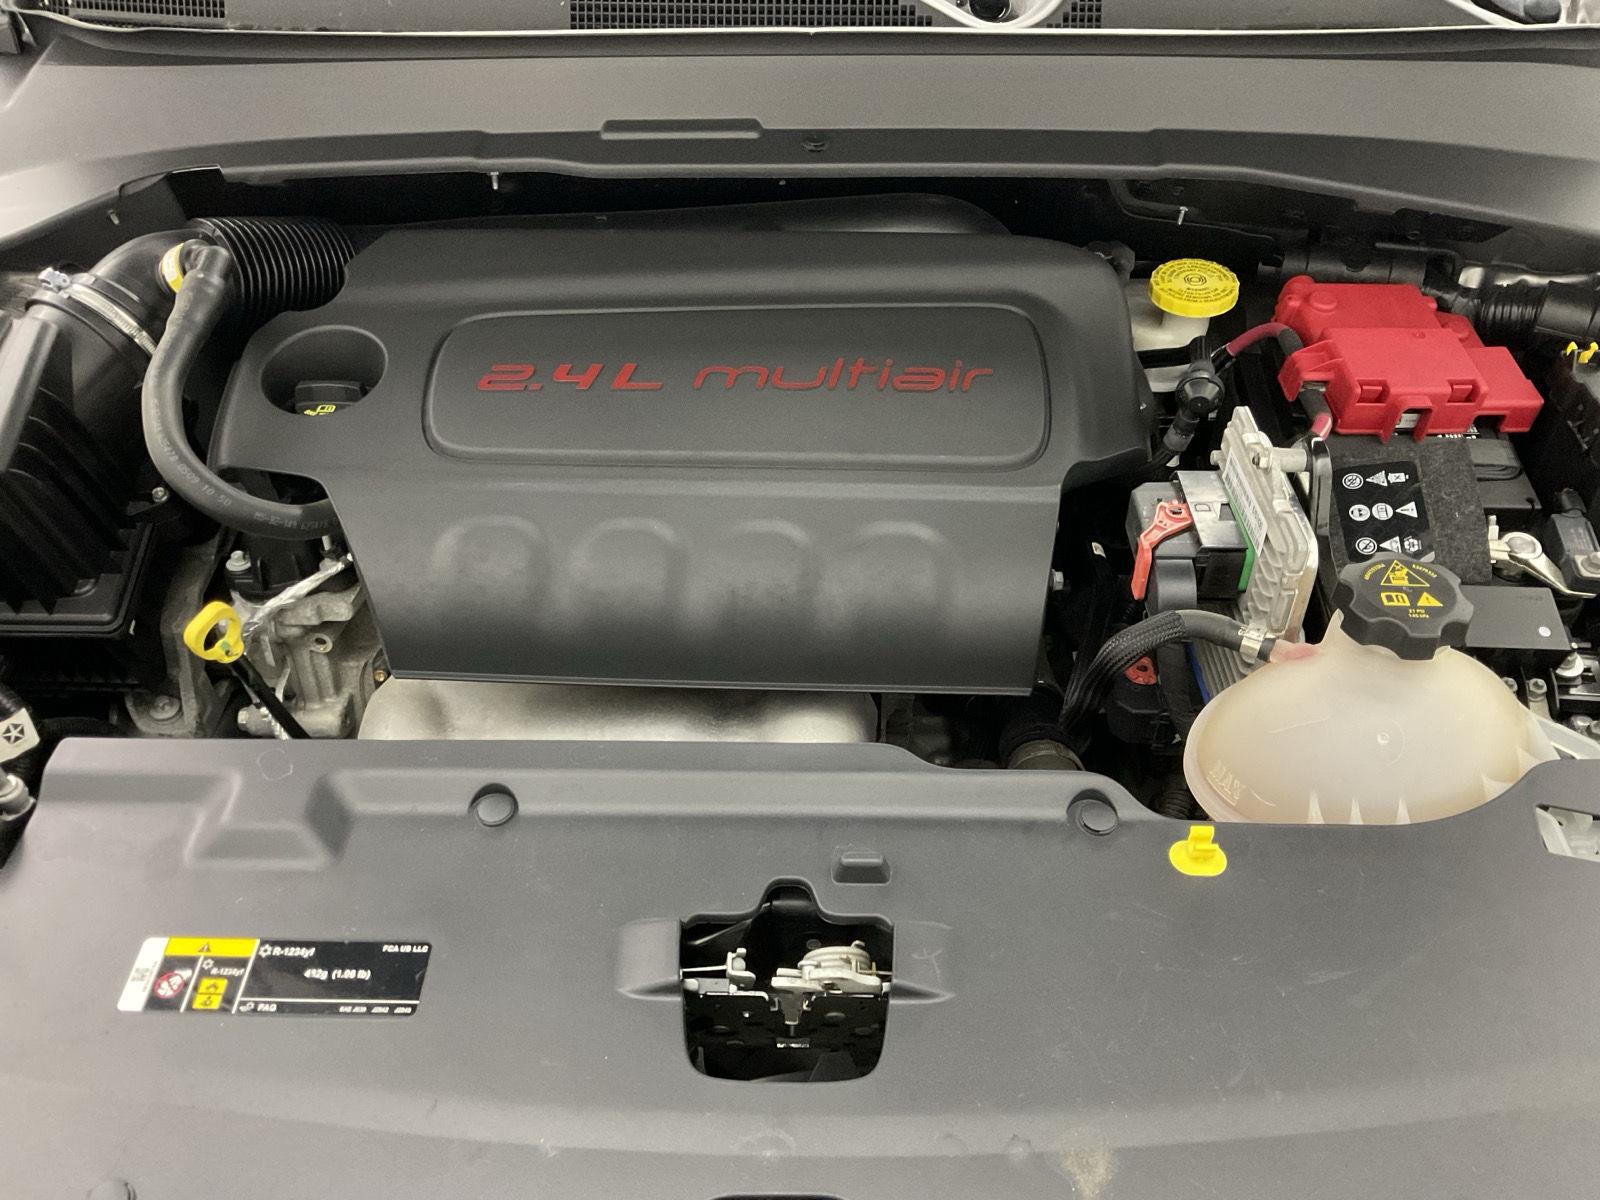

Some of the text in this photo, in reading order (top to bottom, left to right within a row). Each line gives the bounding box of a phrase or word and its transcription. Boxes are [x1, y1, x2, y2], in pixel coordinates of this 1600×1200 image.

[692, 357, 994, 392] multiair
[382, 944, 399, 952] FCA
[413, 945, 429, 953] LLC
